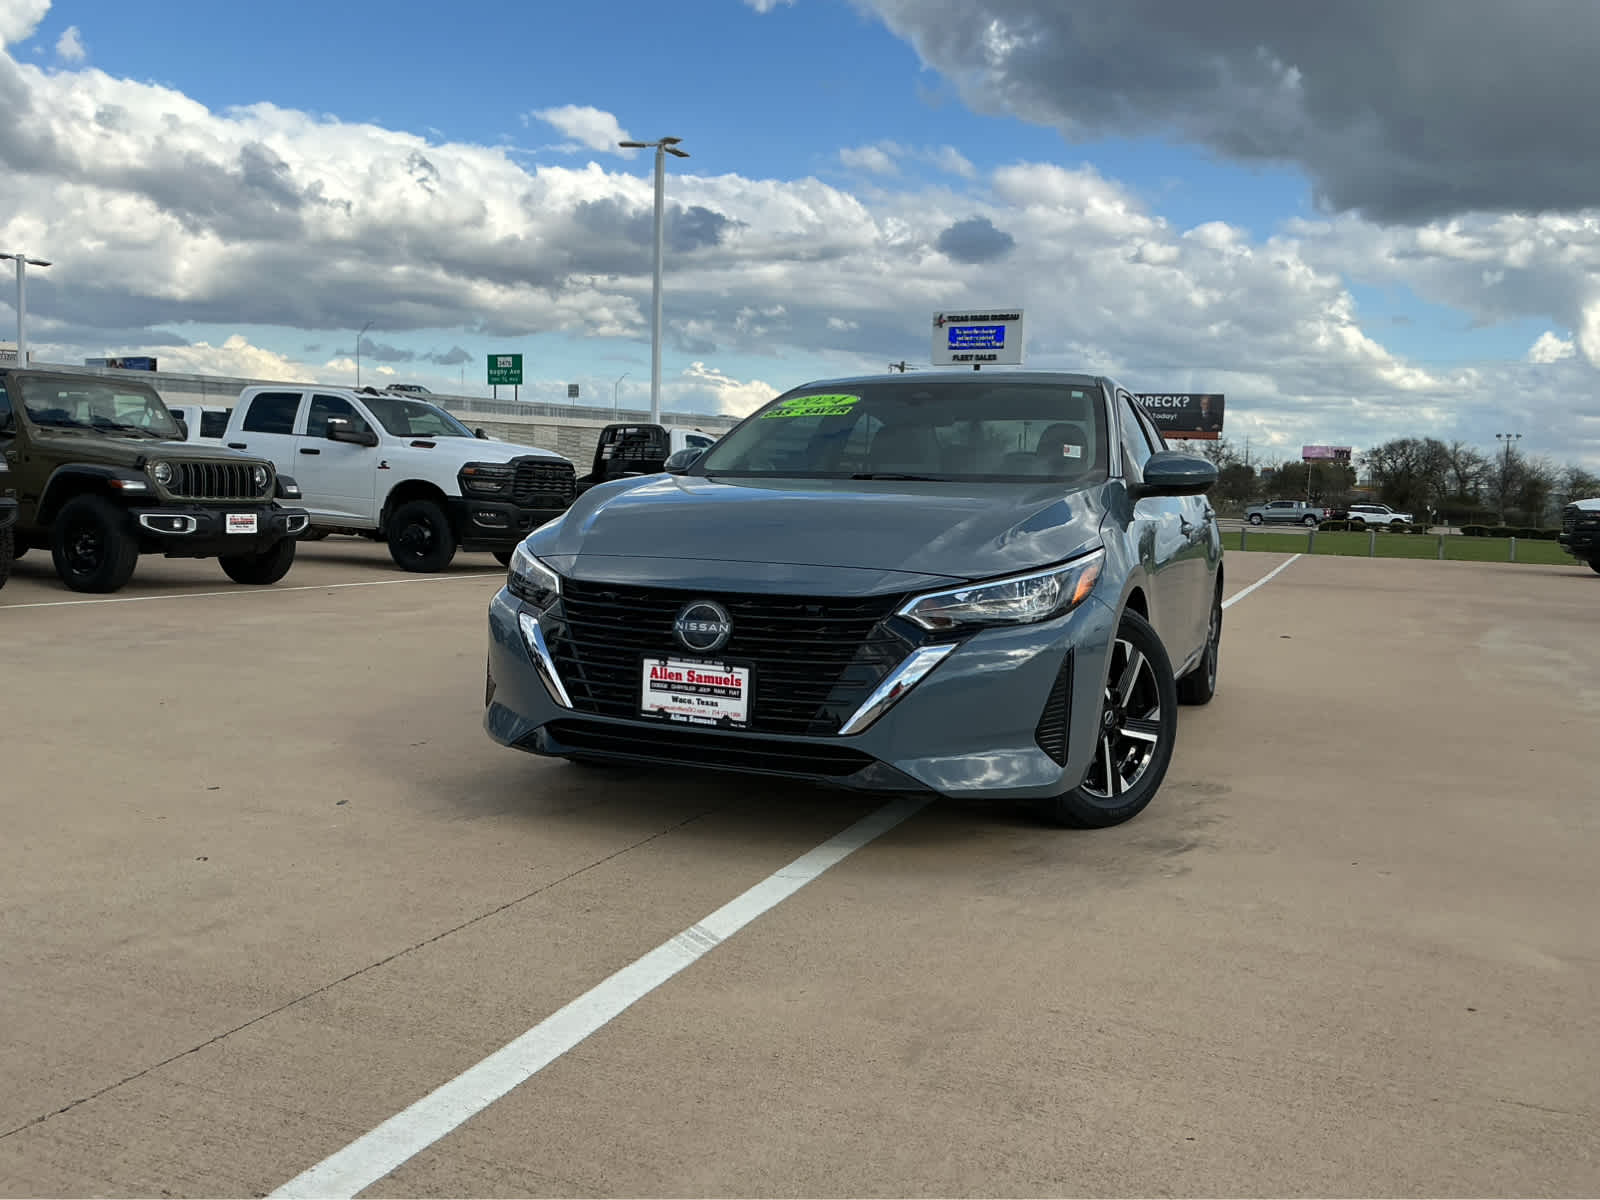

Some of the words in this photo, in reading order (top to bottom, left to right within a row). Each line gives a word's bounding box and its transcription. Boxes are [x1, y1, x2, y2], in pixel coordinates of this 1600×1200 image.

[952, 354, 973, 362] FLEET
[1151, 413, 1178, 421] Today!
[675, 621, 729, 633] NISSAN
[650, 666, 683, 681] Allen
[686, 669, 743, 688] Samuels
[713, 687, 727, 696] RAM
[728, 689, 741, 698] FIAT
[671, 695, 695, 706] Waco,
[695, 697, 719, 708] Texas
